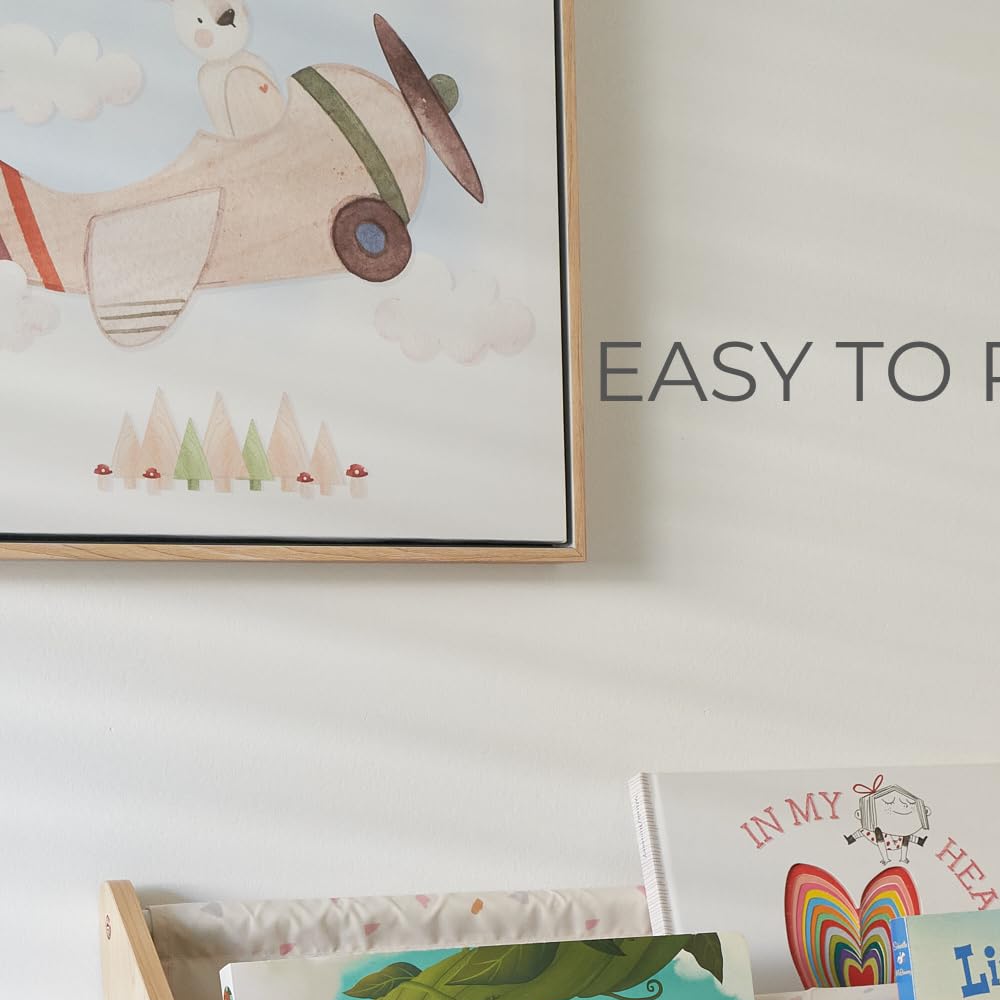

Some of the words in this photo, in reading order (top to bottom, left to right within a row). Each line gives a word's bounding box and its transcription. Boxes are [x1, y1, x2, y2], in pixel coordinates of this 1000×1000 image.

[740, 806, 785, 849] IN
[785, 791, 842, 828] MY
[934, 836, 999, 912] HEA
